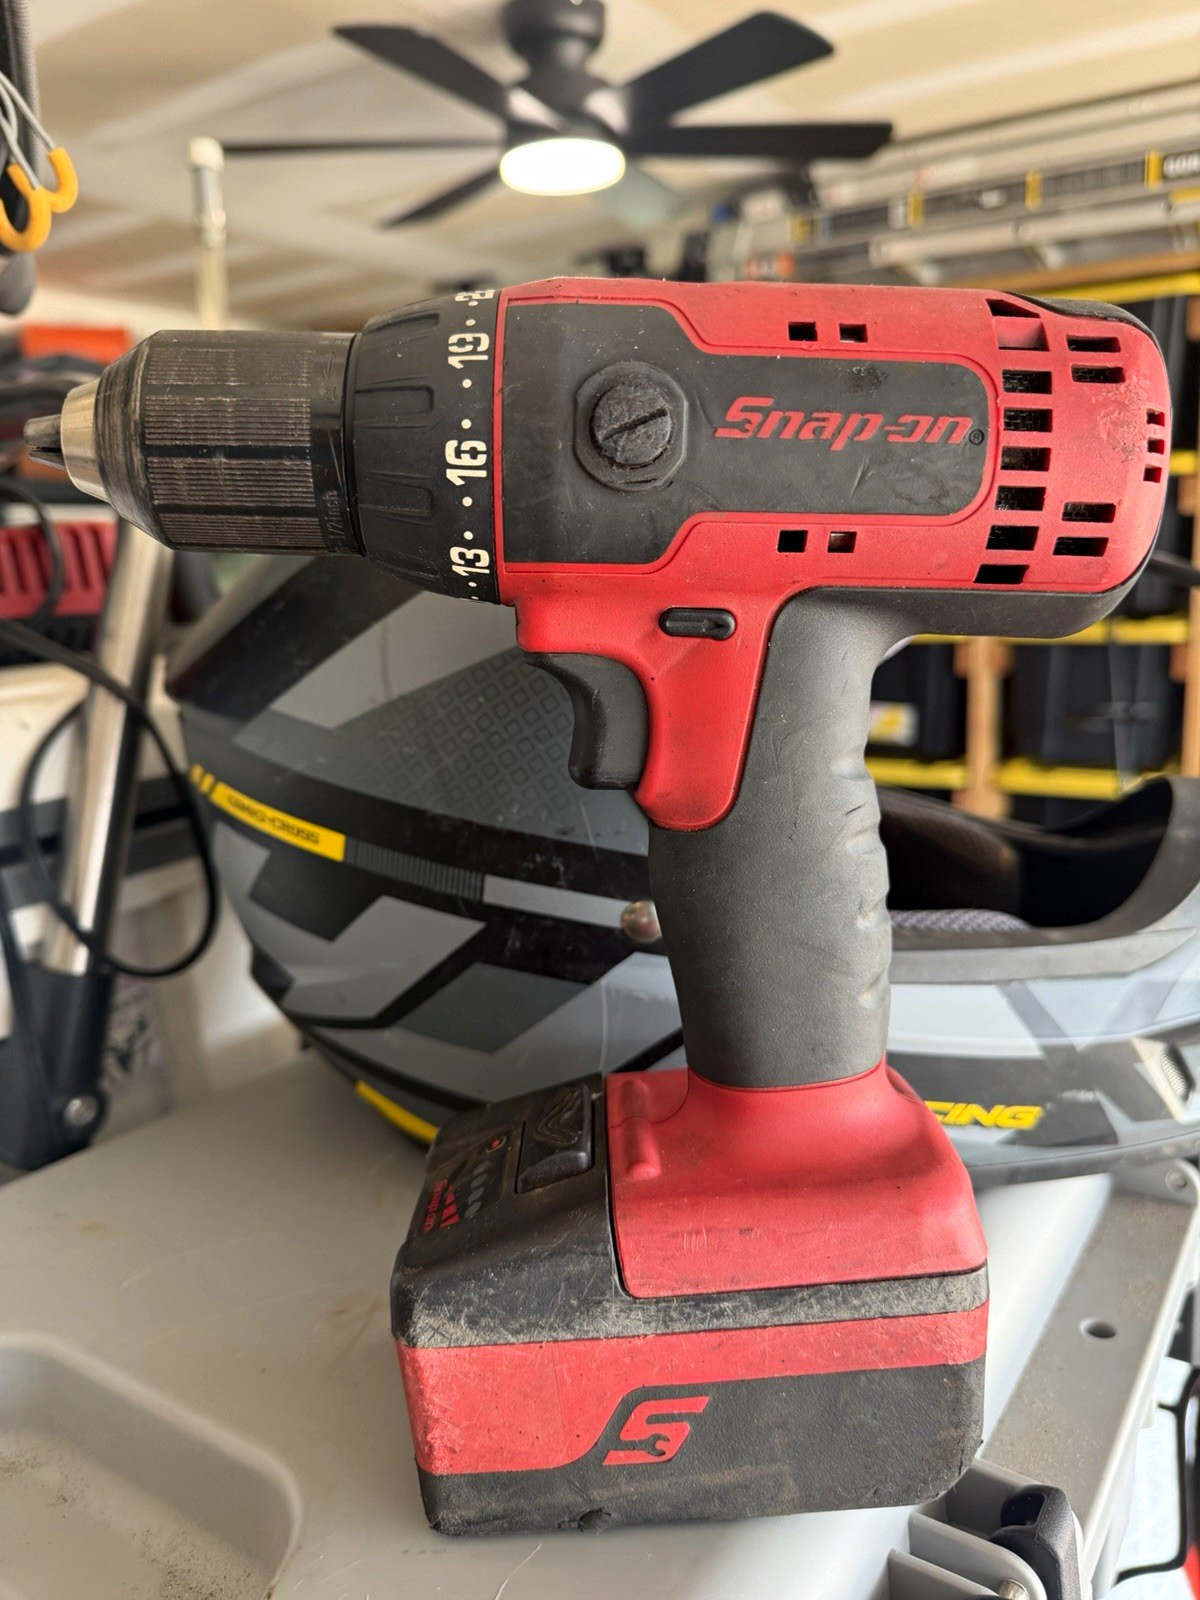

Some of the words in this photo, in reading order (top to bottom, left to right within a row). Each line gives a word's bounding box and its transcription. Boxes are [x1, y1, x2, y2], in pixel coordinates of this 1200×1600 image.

[448, 333, 490, 369] 19
[445, 440, 487, 485] 16
[450, 546, 490, 576] 13
